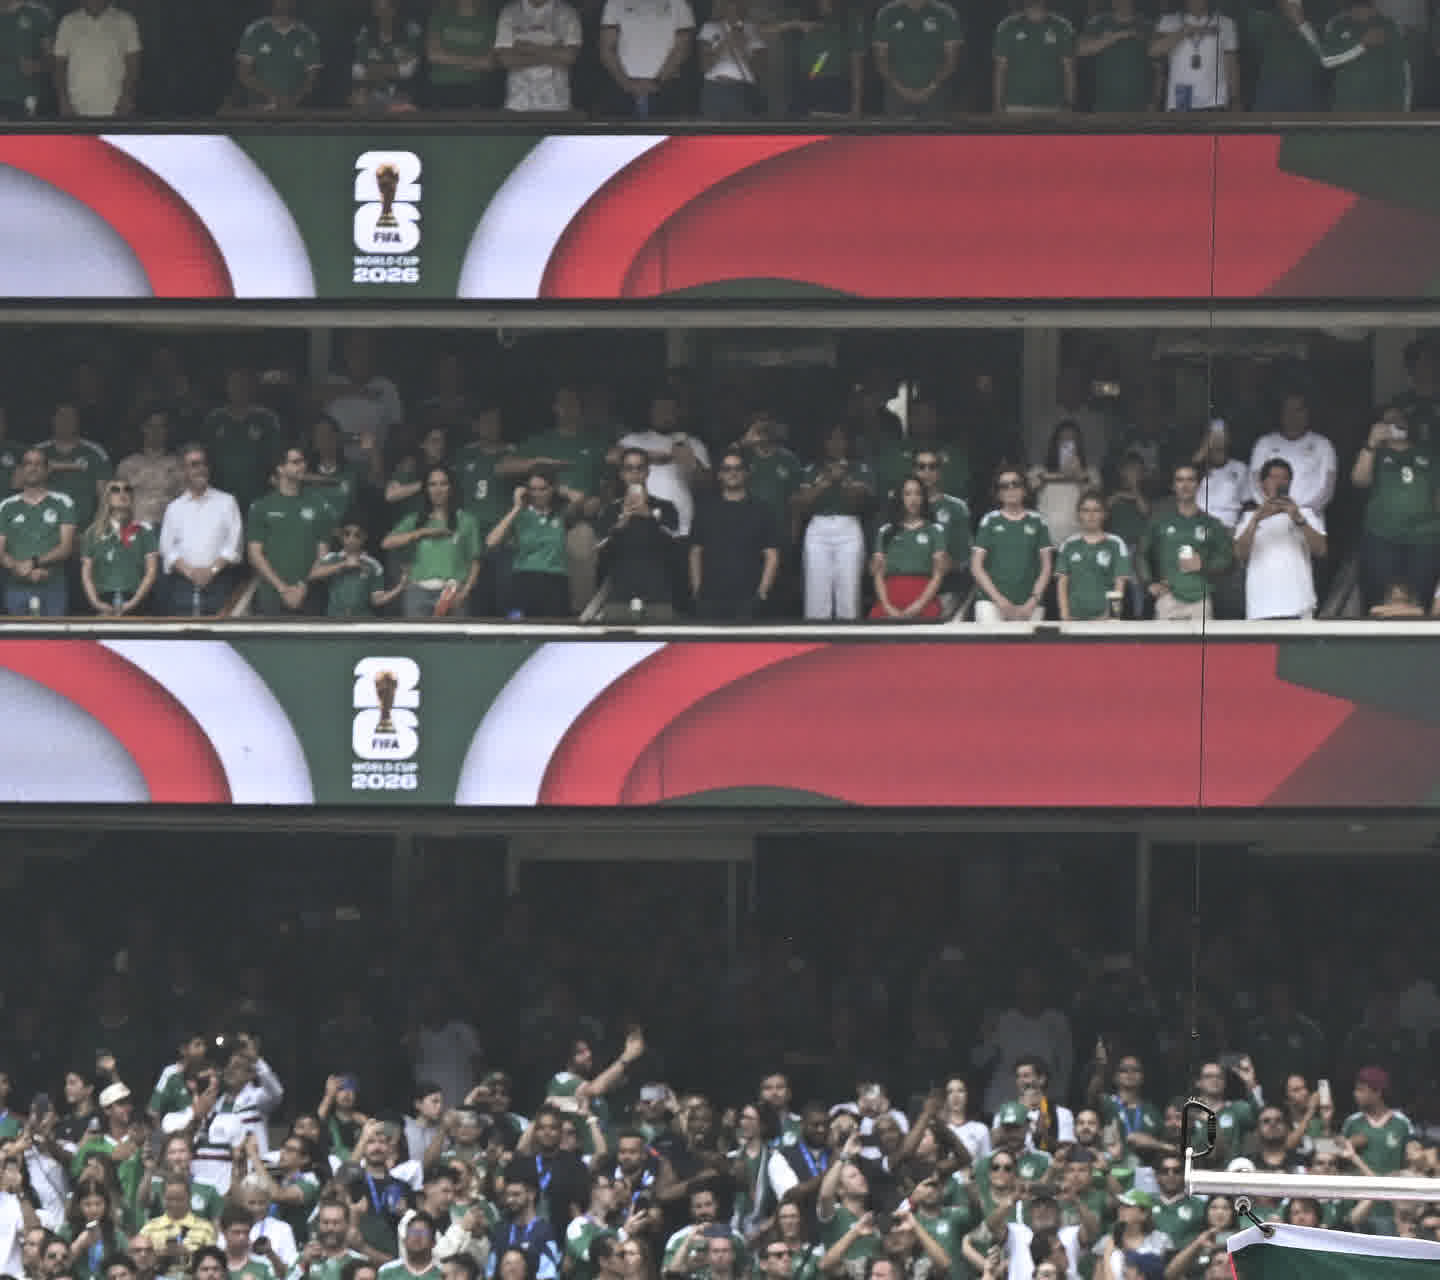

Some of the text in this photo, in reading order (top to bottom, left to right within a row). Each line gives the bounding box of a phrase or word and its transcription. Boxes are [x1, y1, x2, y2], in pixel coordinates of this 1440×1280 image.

[373, 231, 402, 243] FIFA
[352, 266, 420, 283] 2026
[371, 738, 400, 750] FIFA
[351, 772, 419, 790] 2026
